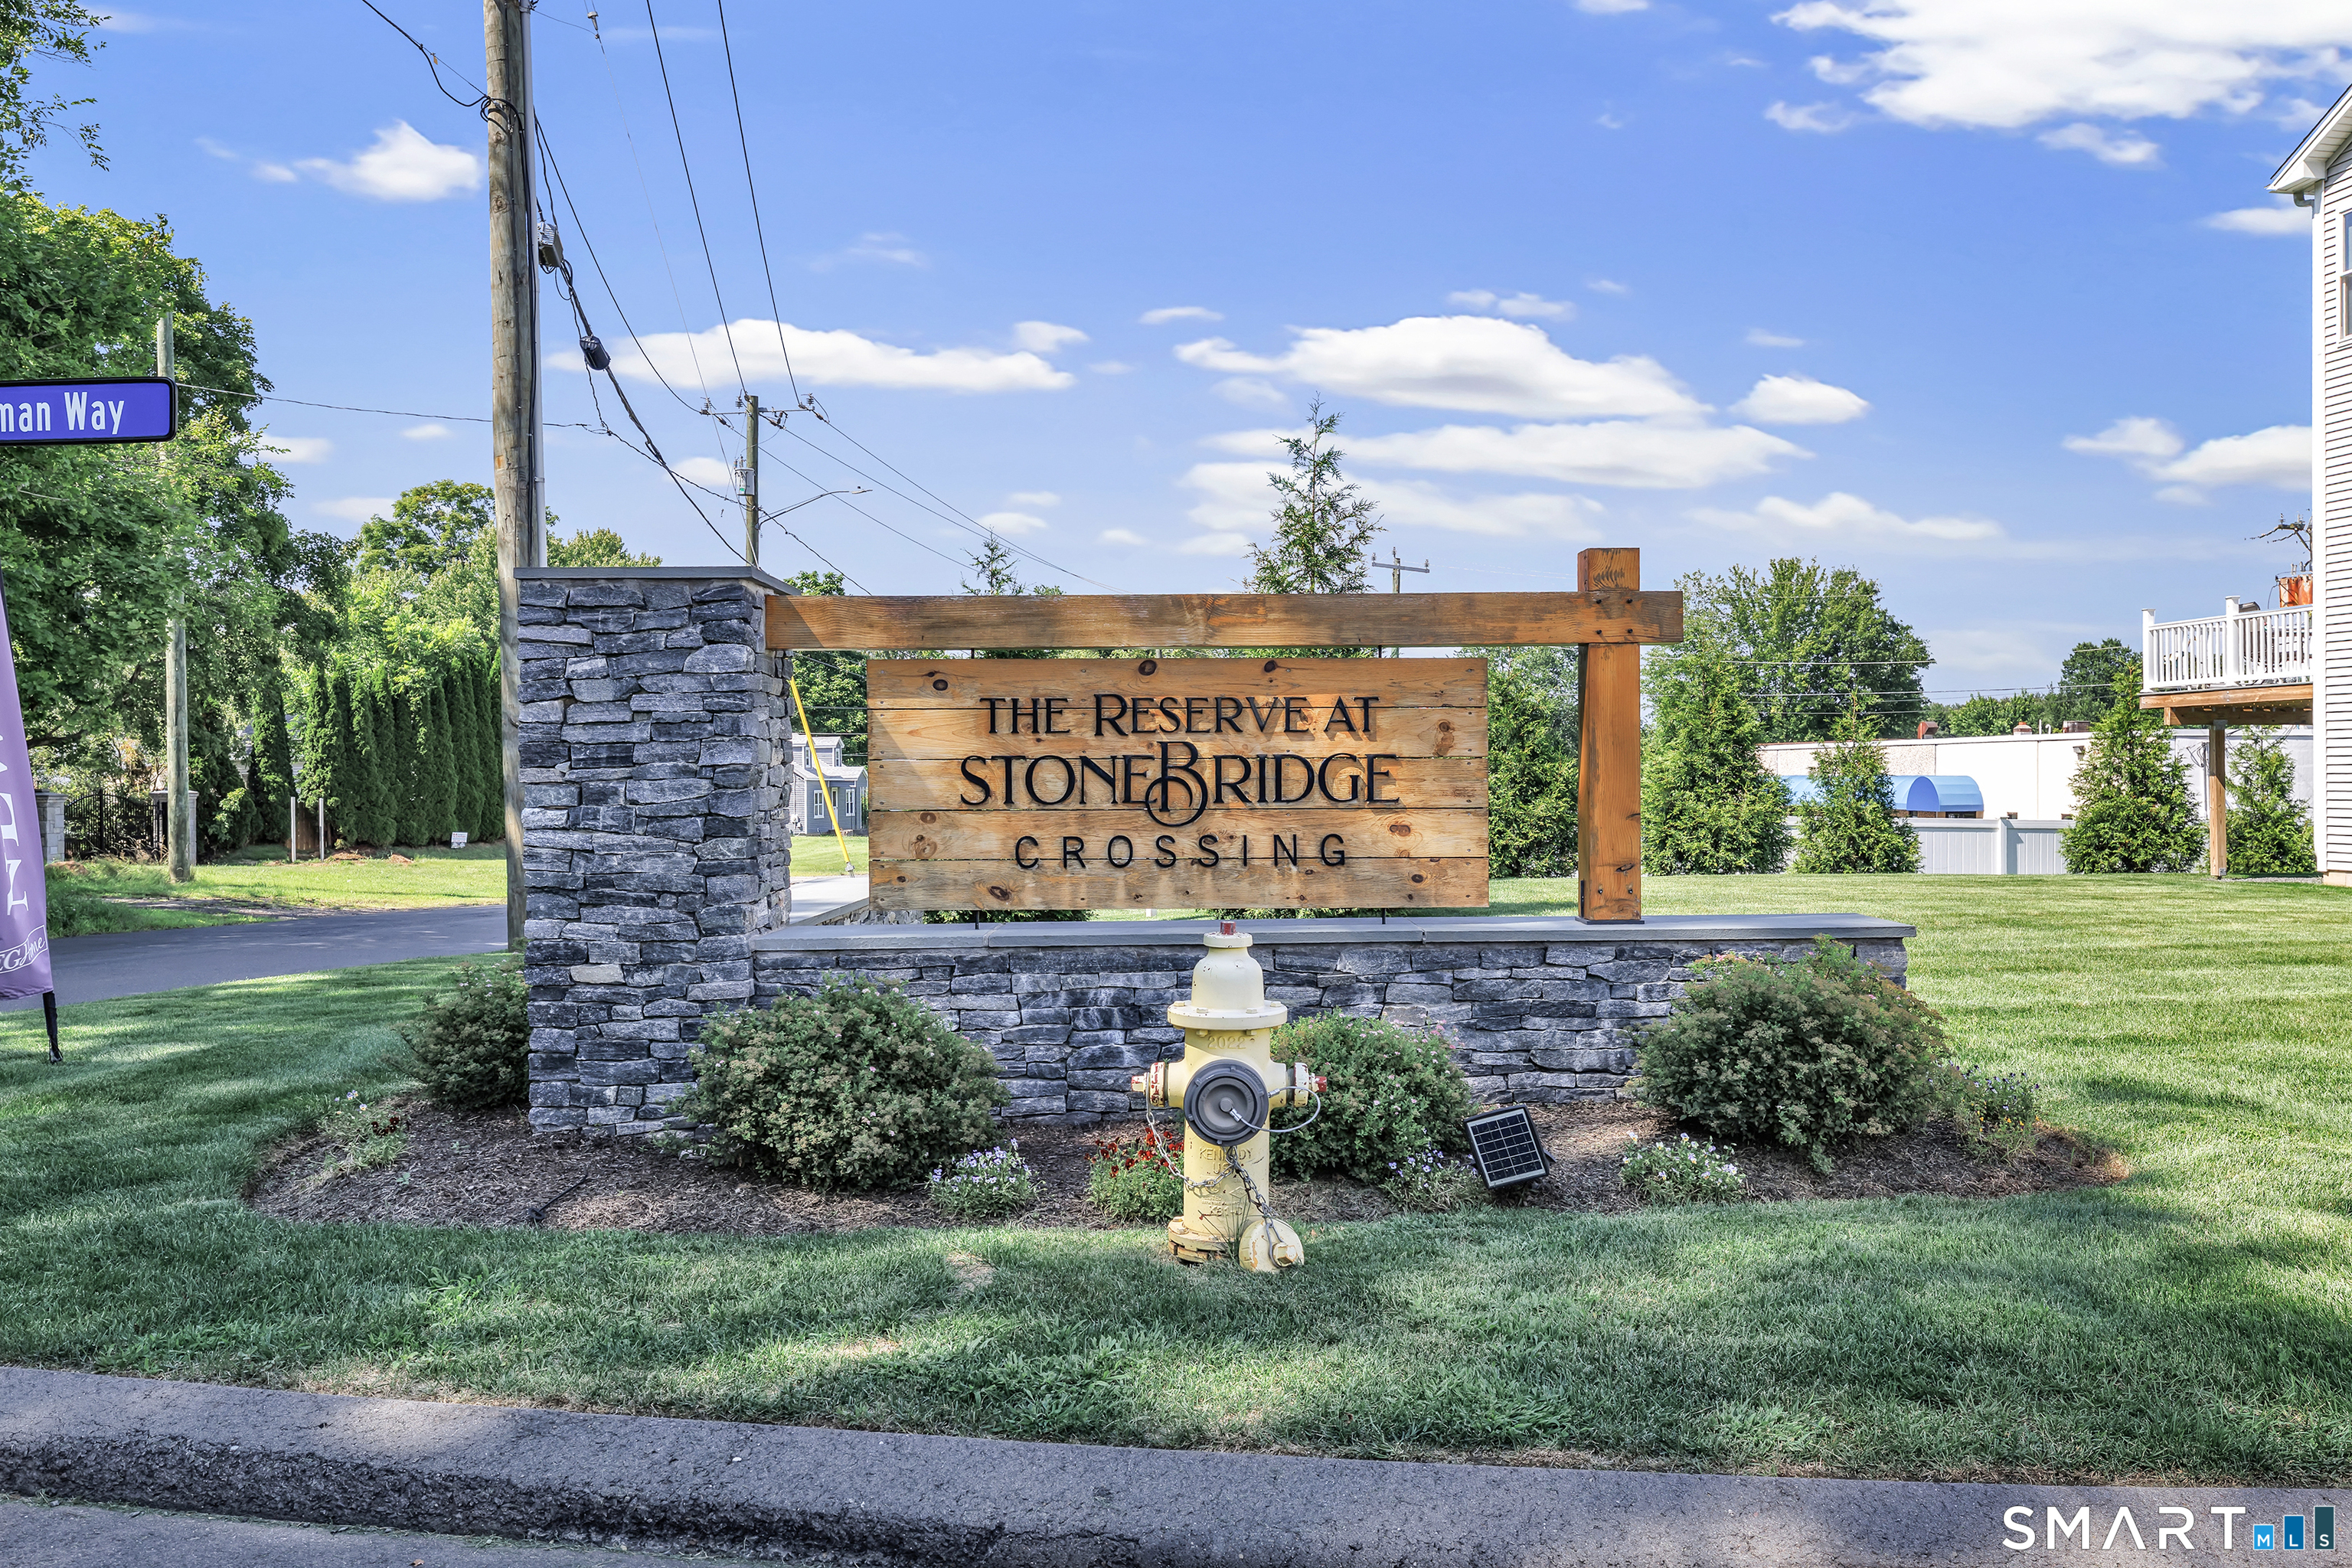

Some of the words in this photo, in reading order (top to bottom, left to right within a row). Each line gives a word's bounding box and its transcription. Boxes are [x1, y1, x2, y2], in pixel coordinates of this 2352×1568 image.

[64, 391, 125, 435] Way
[979, 697, 1070, 734] THE
[1323, 695, 1380, 733] AT
[1014, 834, 1346, 869] CROSSING
[1207, 1035, 1246, 1050] 2022
[1200, 1148, 1253, 1161] KENDY
